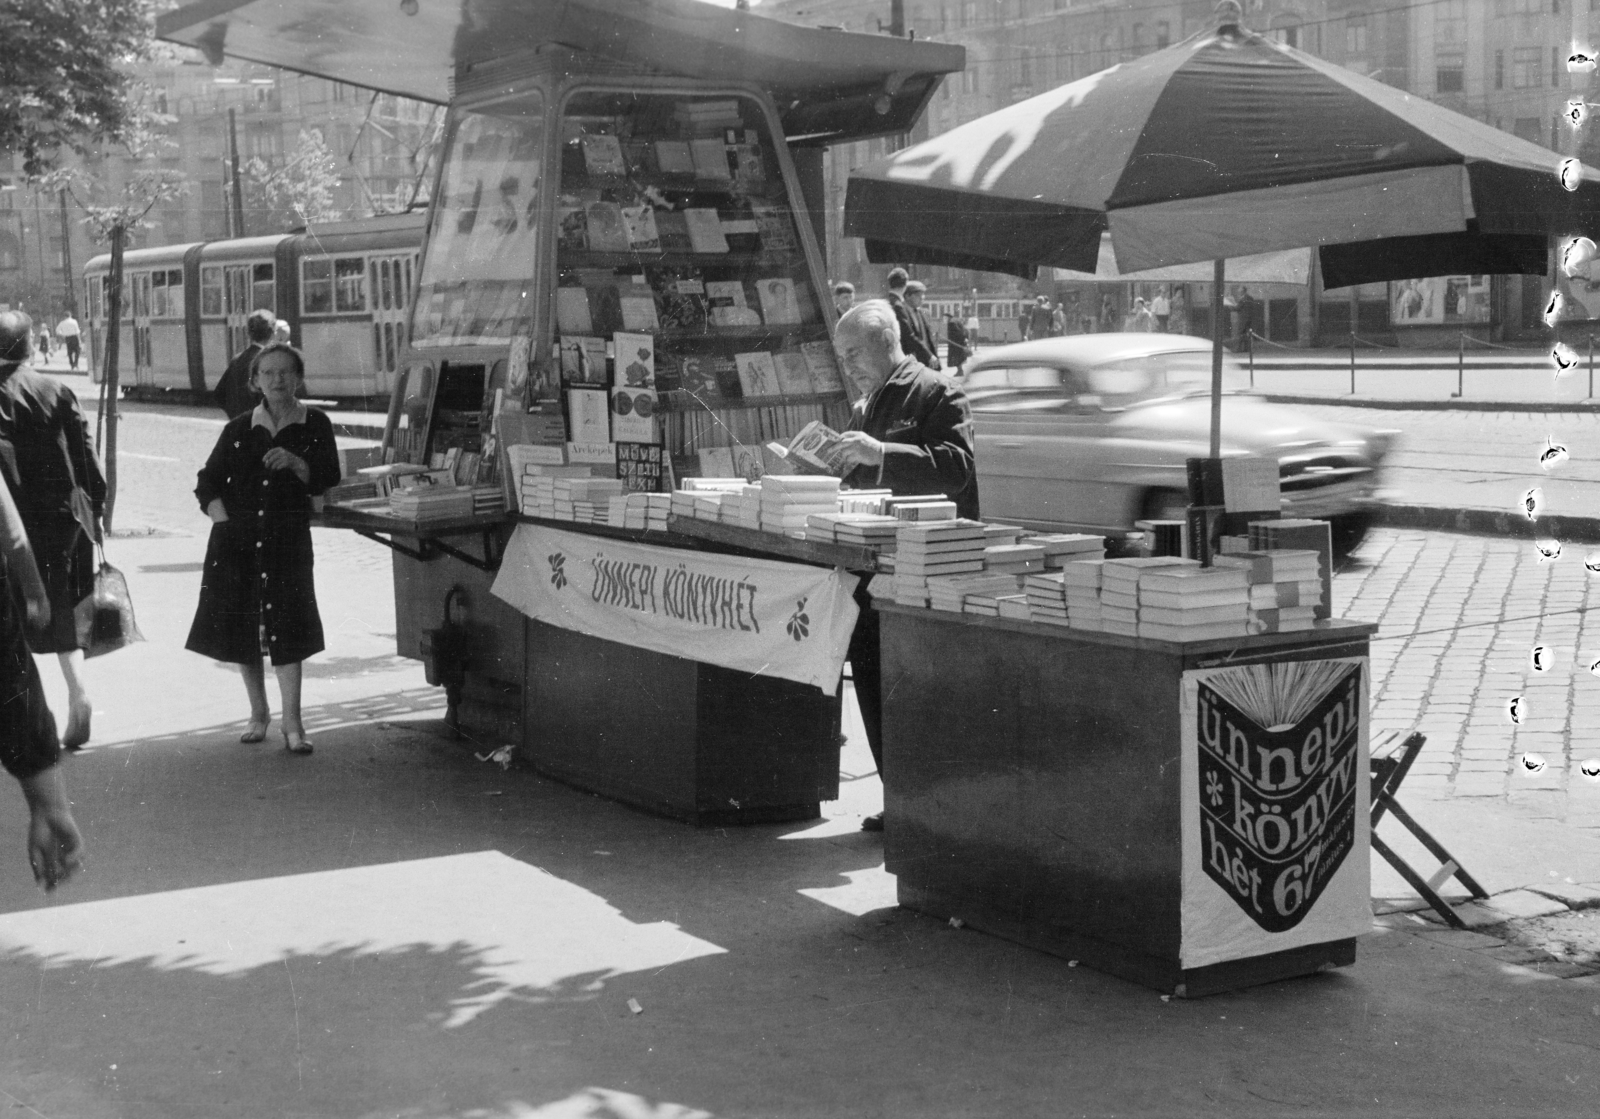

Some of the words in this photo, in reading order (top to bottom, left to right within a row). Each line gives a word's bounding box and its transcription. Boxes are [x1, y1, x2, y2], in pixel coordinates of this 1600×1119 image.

[591, 552, 658, 613] ÜNNEPI
[662, 563, 761, 634] KÖNYVHÉT
[1199, 677, 1358, 791] ünnepi
[1231, 746, 1357, 856] könyv
[1206, 818, 1263, 914] hét
[1273, 838, 1323, 917] 67
